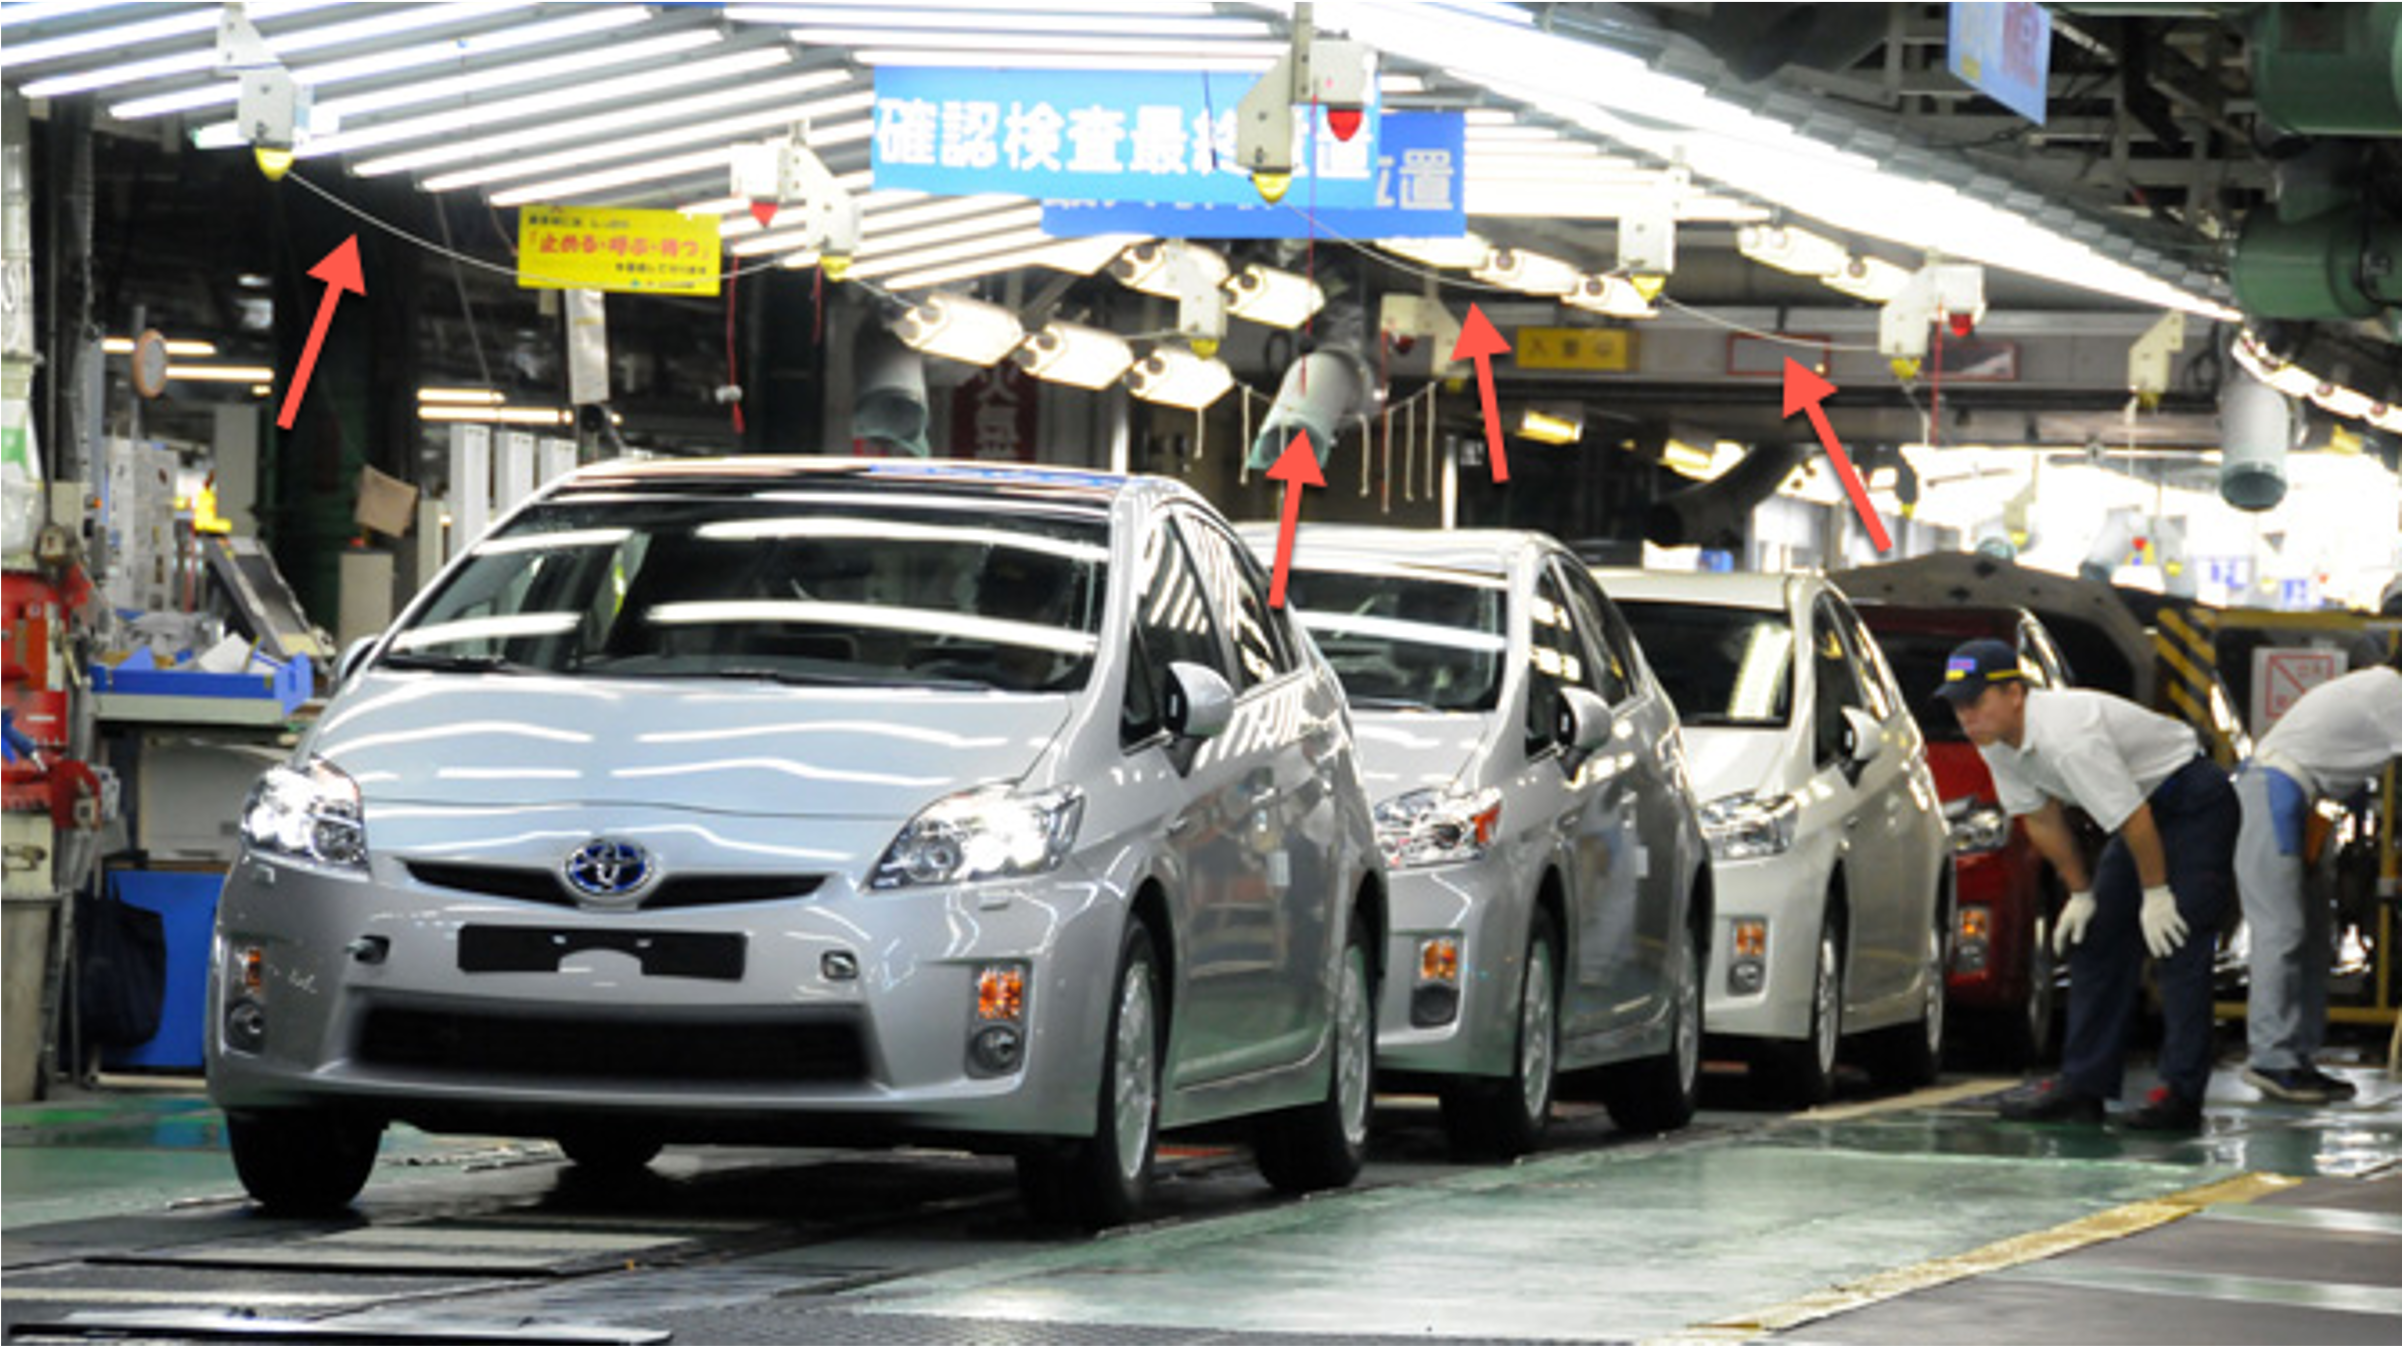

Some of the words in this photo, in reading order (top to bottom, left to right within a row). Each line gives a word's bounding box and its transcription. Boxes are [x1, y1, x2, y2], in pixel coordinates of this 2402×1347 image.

[875, 98, 1371, 178] 確認検査最終置
